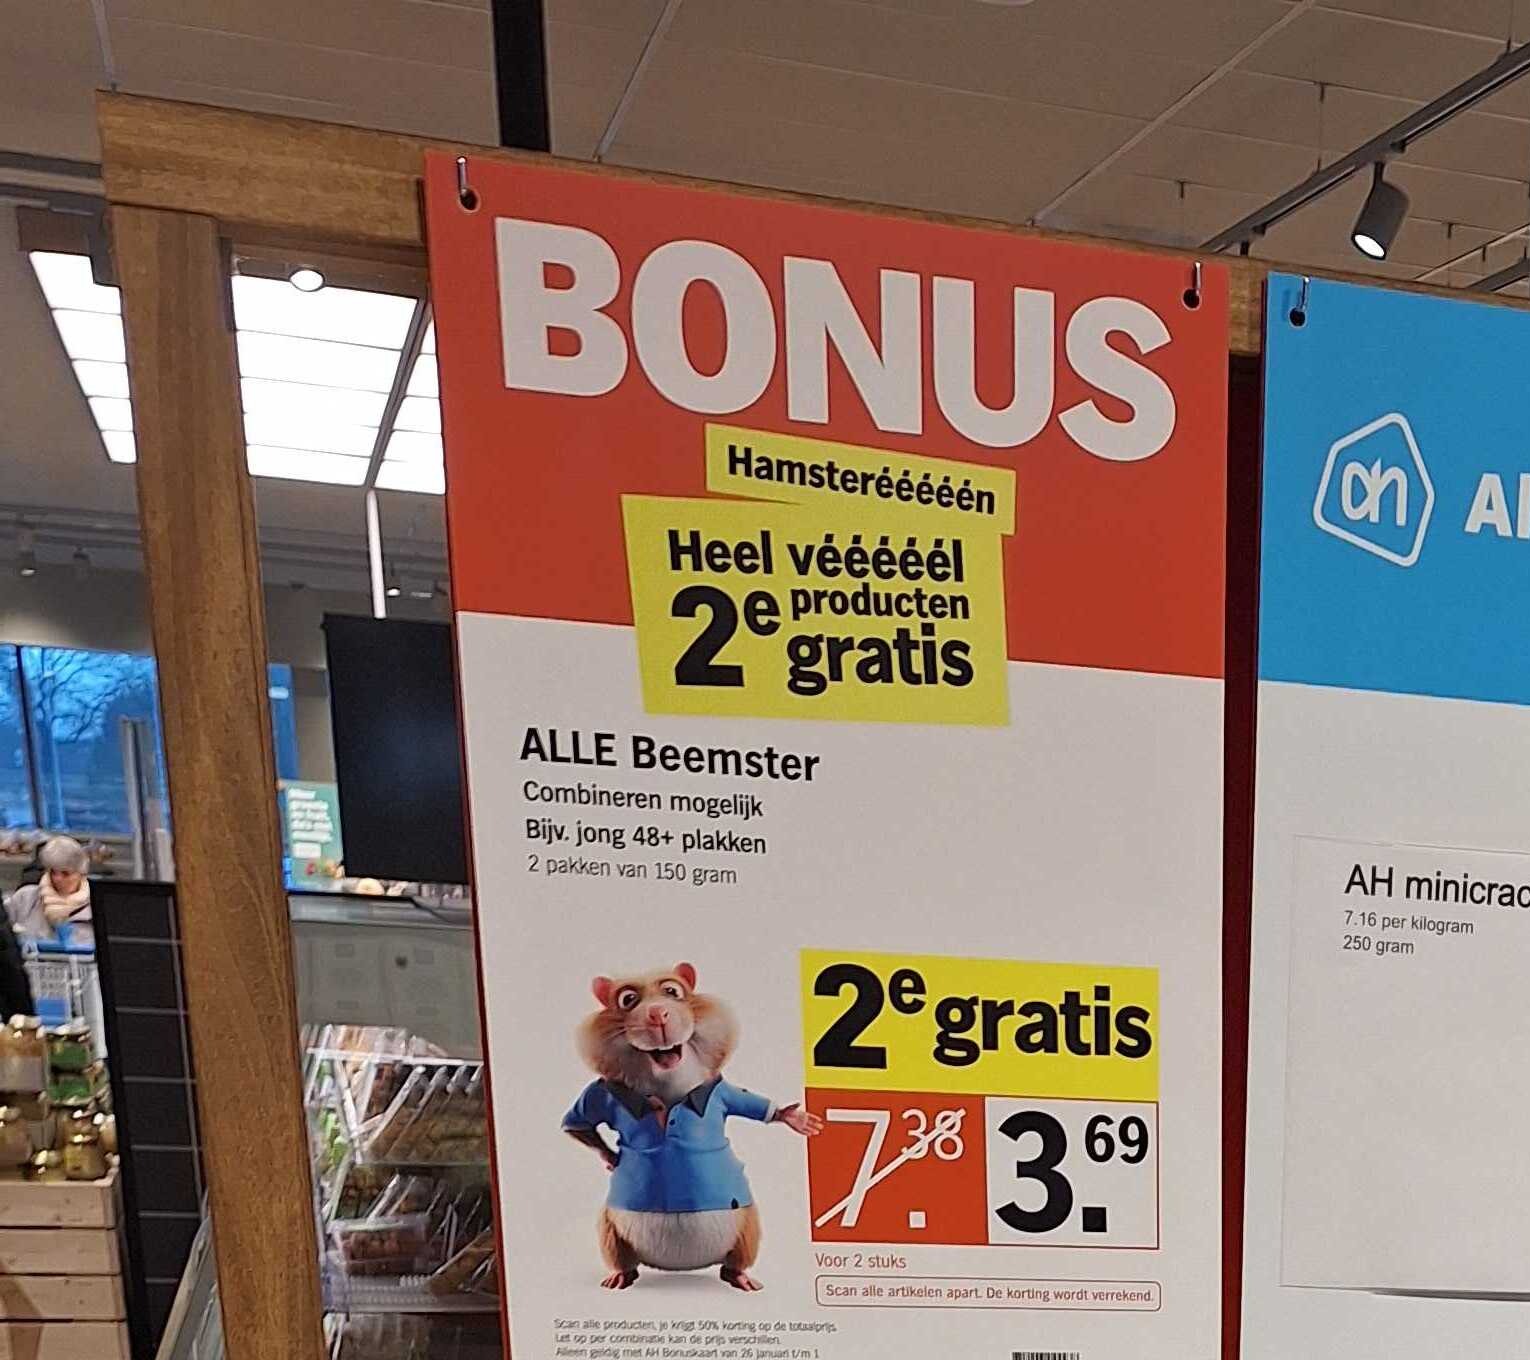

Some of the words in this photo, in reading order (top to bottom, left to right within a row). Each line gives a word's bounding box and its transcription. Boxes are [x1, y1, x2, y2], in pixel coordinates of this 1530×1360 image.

[493, 216, 1178, 463] BONUS
[728, 444, 995, 515] Hamsterééééén
[668, 529, 774, 575] Heel
[787, 533, 964, 582] vééééél
[791, 582, 970, 622] producten
[786, 622, 975, 697] gratis
[520, 727, 618, 767] ALLE
[632, 734, 820, 781] Beemster
[524, 780, 661, 810] Combineren
[670, 793, 764, 821] mogelijk
[526, 818, 570, 845] Bijv.
[575, 820, 626, 850] jong
[632, 826, 675, 848] 48+
[682, 829, 767, 854] plakken
[528, 854, 539, 873] 2
[546, 856, 611, 877] pakken
[616, 863, 648, 880] van
[655, 861, 687, 882] 150
[692, 867, 737, 887] gram
[1344, 863, 1394, 898] AH
[1343, 909, 1378, 928] 7.16
[1381, 914, 1407, 932] per
[1410, 914, 1475, 937] kilogram
[1342, 935, 1372, 952] 250
[1375, 938, 1415, 957] gram
[813, 963, 927, 1070] 2e
[933, 984, 1153, 1067] gratis
[994, 1109, 1150, 1233] 3.69
[815, 1252, 849, 1268] Voor
[853, 1253, 863, 1268] 2
[868, 1253, 907, 1270] stuks
[825, 1283, 858, 1298] Scan
[861, 1284, 885, 1299] alle
[888, 1284, 943, 1300] artikelen
[986, 1286, 1003, 1300] De
[1007, 1286, 1051, 1304] korting
[1053, 1287, 1089, 1302] wordt
[1091, 1287, 1155, 1303] verrekend.
